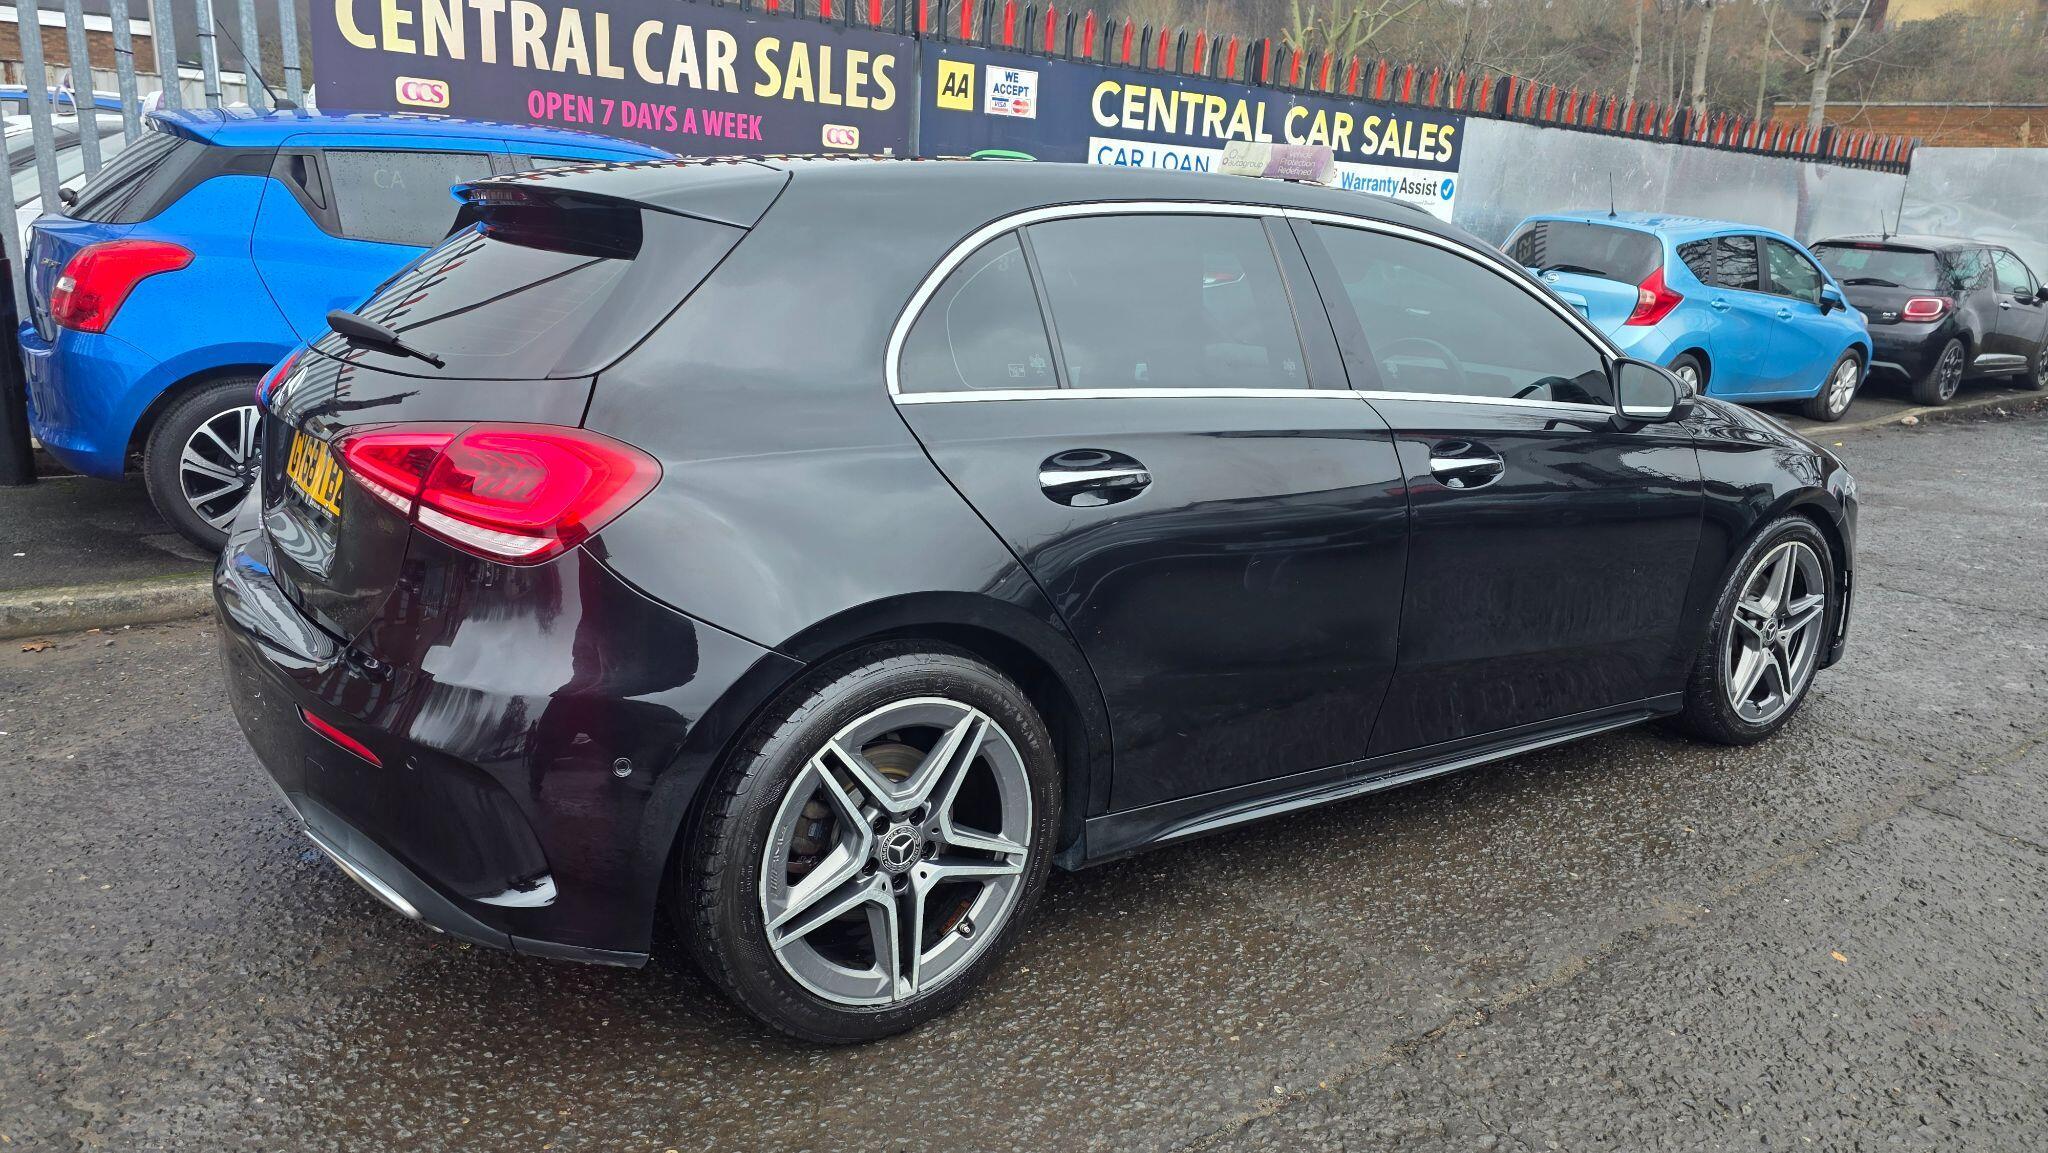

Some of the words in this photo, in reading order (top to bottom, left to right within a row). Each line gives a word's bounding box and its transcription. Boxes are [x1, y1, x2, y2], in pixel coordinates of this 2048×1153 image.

[335, 0, 625, 79] CENTRAL
[632, 20, 739, 94] CAR
[754, 36, 896, 111] SALES
[942, 72, 969, 98] AA
[1005, 71, 1019, 83] WE
[402, 82, 444, 104] CCS
[993, 83, 1029, 97] ACCEPT
[528, 90, 594, 124] OPEN
[601, 99, 615, 126] 7
[621, 100, 677, 135] DAYS
[683, 108, 697, 135] A
[702, 109, 763, 141] WEEK
[1091, 80, 1273, 143] CENTRAL
[1284, 105, 1354, 152] CAR
[1361, 115, 1456, 163] SALES
[1098, 146, 1144, 167] CAR
[1278, 166, 1313, 176] Redefined
